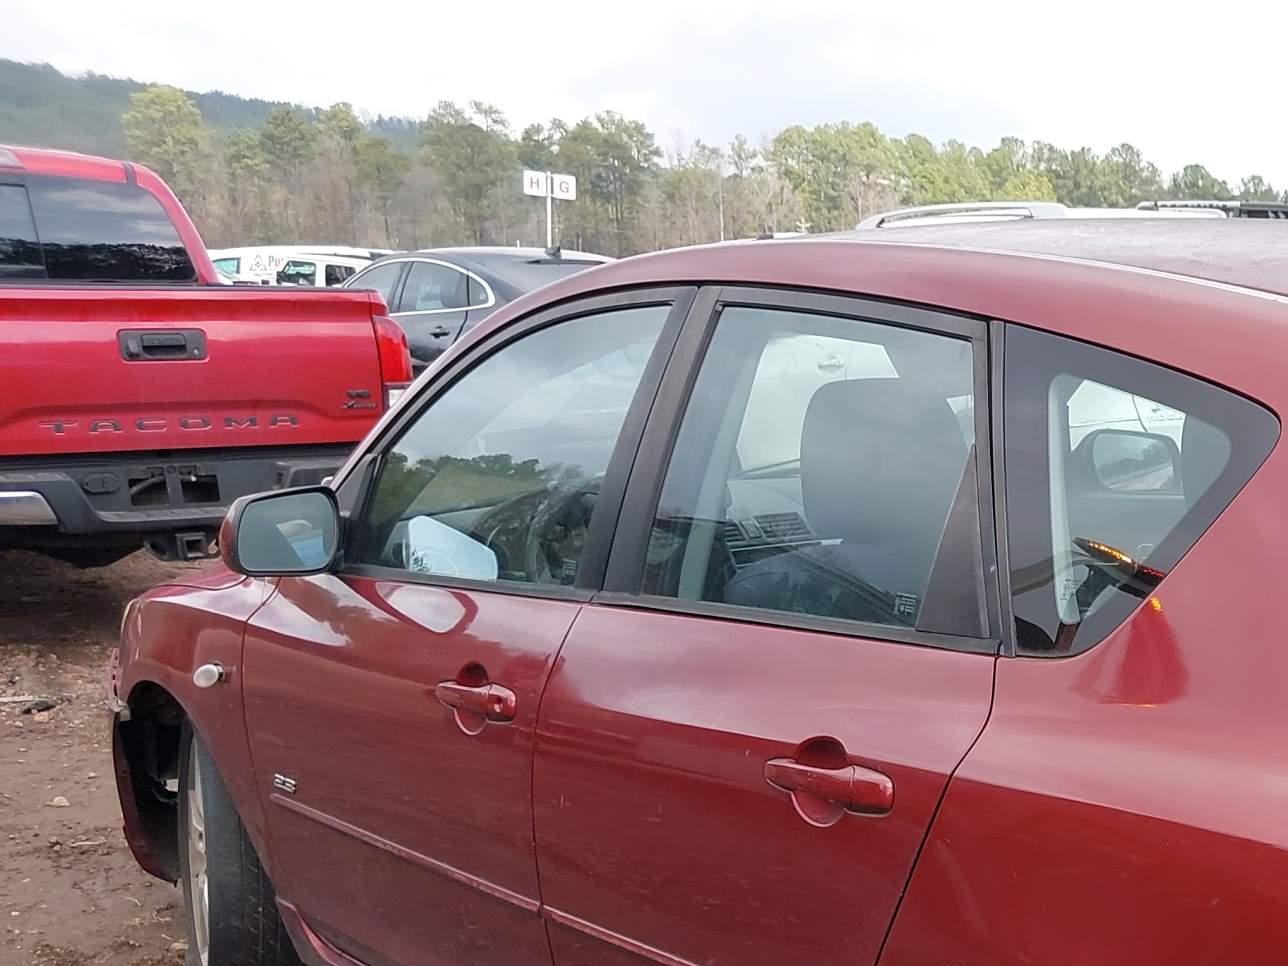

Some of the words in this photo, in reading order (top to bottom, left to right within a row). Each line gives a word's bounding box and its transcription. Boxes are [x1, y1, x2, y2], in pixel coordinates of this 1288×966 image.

[530, 176, 540, 190] H
[559, 180, 569, 194] G
[38, 412, 300, 436] TACOMA
